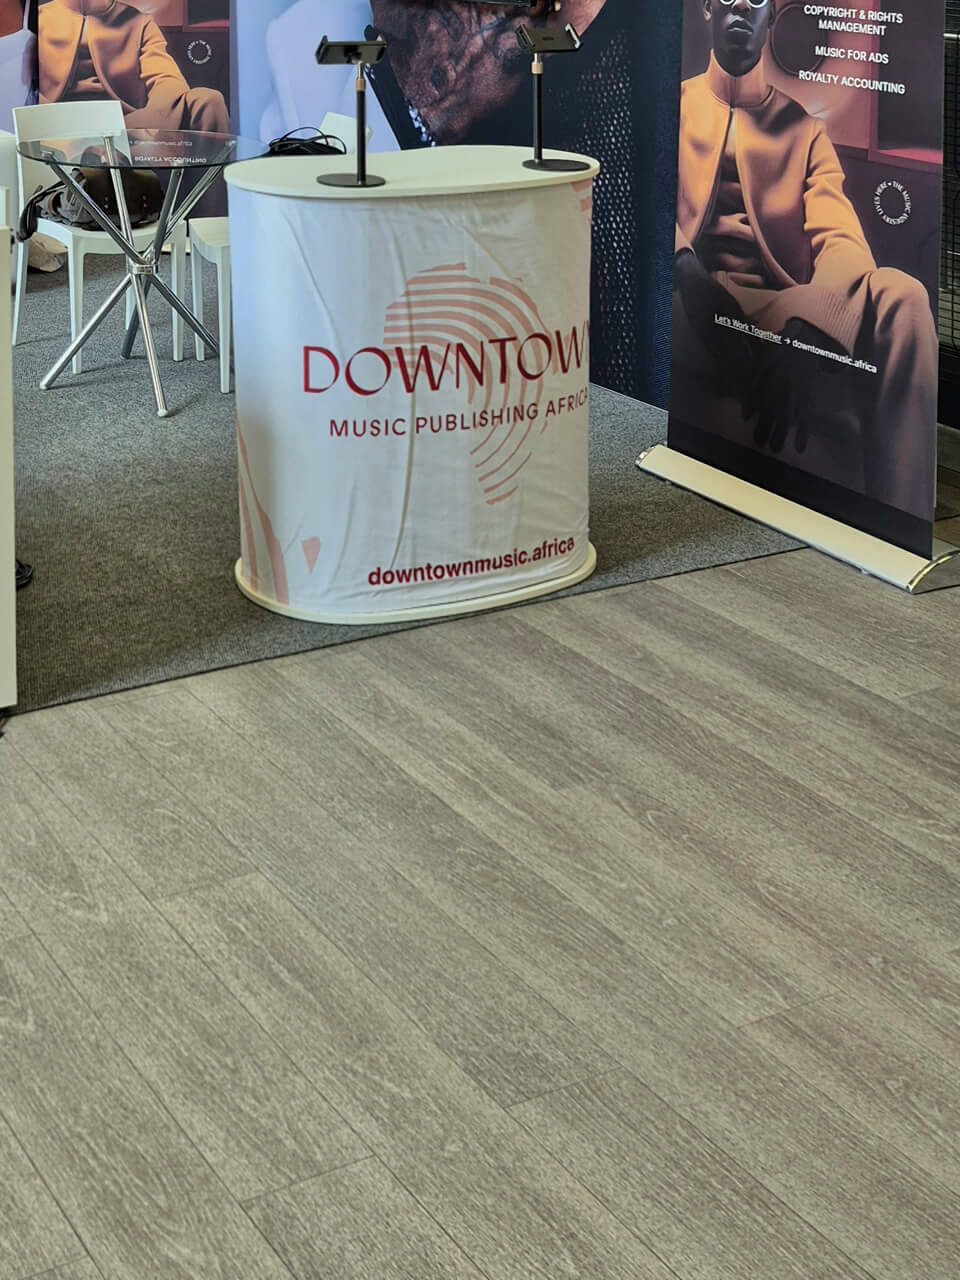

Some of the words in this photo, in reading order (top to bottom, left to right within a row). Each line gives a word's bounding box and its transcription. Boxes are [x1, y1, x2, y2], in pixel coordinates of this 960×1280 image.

[803, 4, 857, 19] COPYRIGHT
[858, 9, 866, 20] &
[867, 10, 904, 24] RIGHTS
[818, 19, 887, 36] MANAGEMENT
[815, 45, 846, 59] MUSIC
[847, 49, 867, 61] FOR
[868, 52, 889, 65] ADS
[798, 70, 840, 86] ROYALTY
[840, 75, 906, 95] ACCOUNTING
[303, 320, 590, 396] DOWNTOW
[714, 313, 732, 325] Let's
[732, 319, 750, 332] Work
[751, 325, 782, 343] Together
[792, 338, 878, 374] downtownmusic.africa
[329, 417, 407, 438] MUSIC
[415, 401, 539, 435] PUBLISHING
[367, 536, 576, 587] downtownmusic.africa
